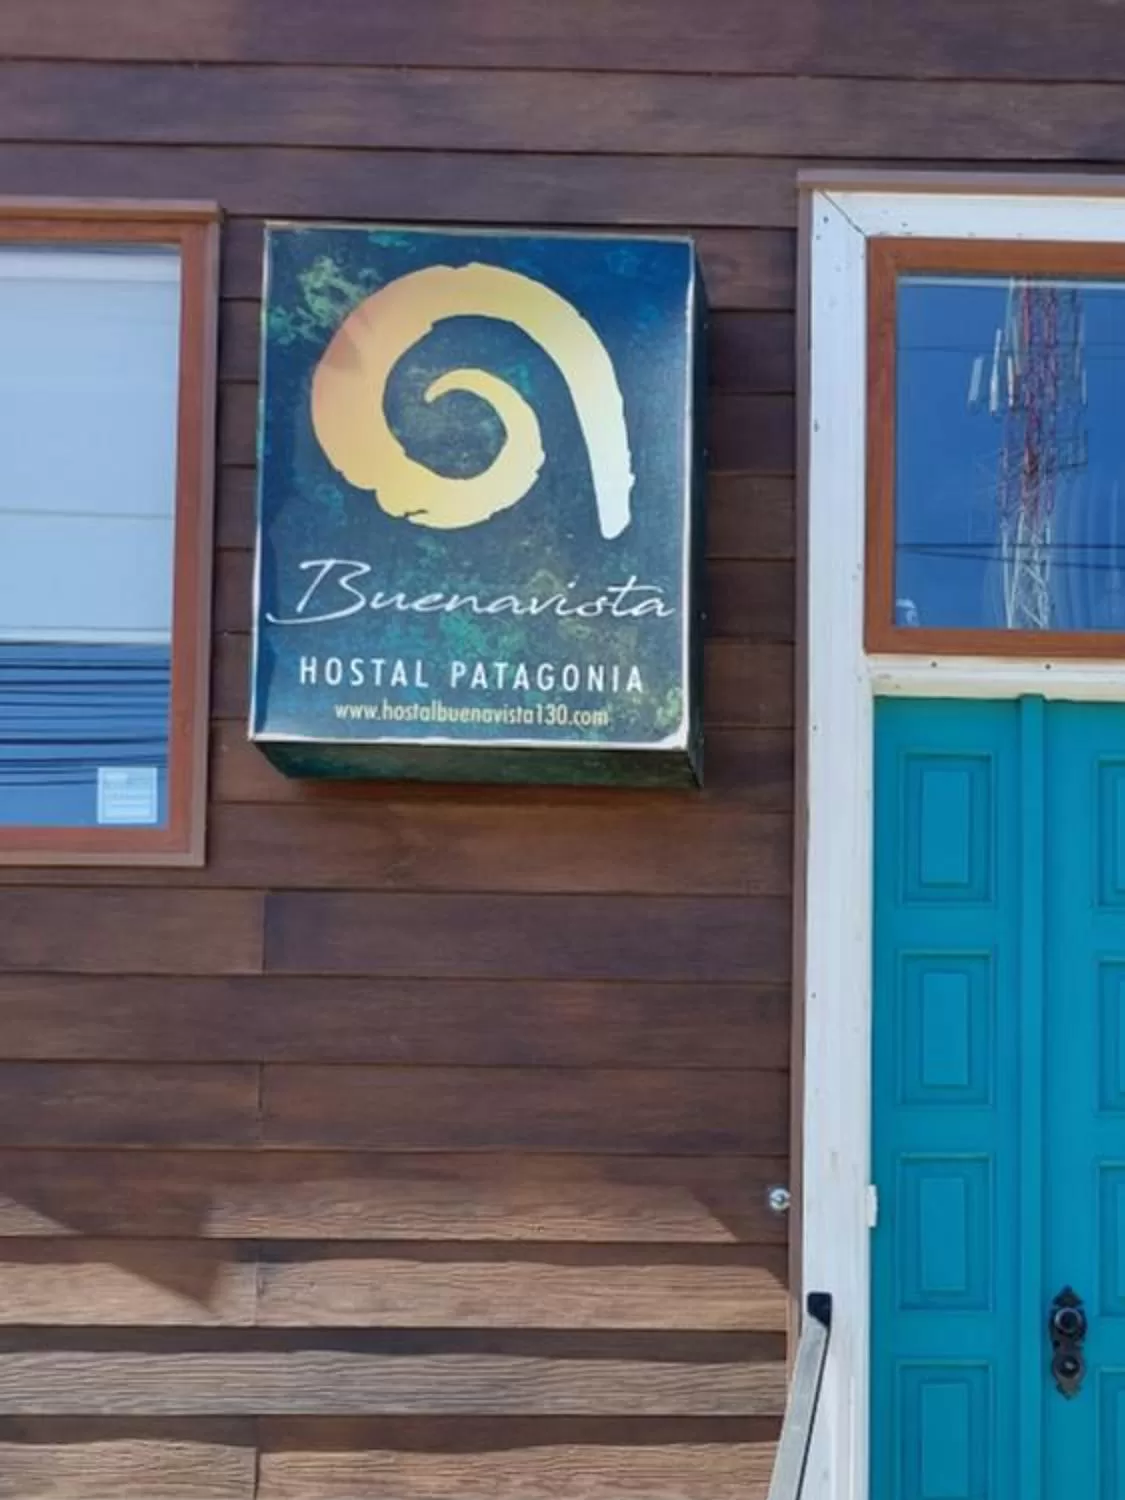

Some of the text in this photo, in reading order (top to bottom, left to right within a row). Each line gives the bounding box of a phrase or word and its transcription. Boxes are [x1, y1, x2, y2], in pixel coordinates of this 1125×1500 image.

[265, 558, 677, 626] Buenavista
[299, 655, 645, 693] HOSTAL PATAGONIA
[333, 701, 611, 728] www.hostalbuenavista130.com
